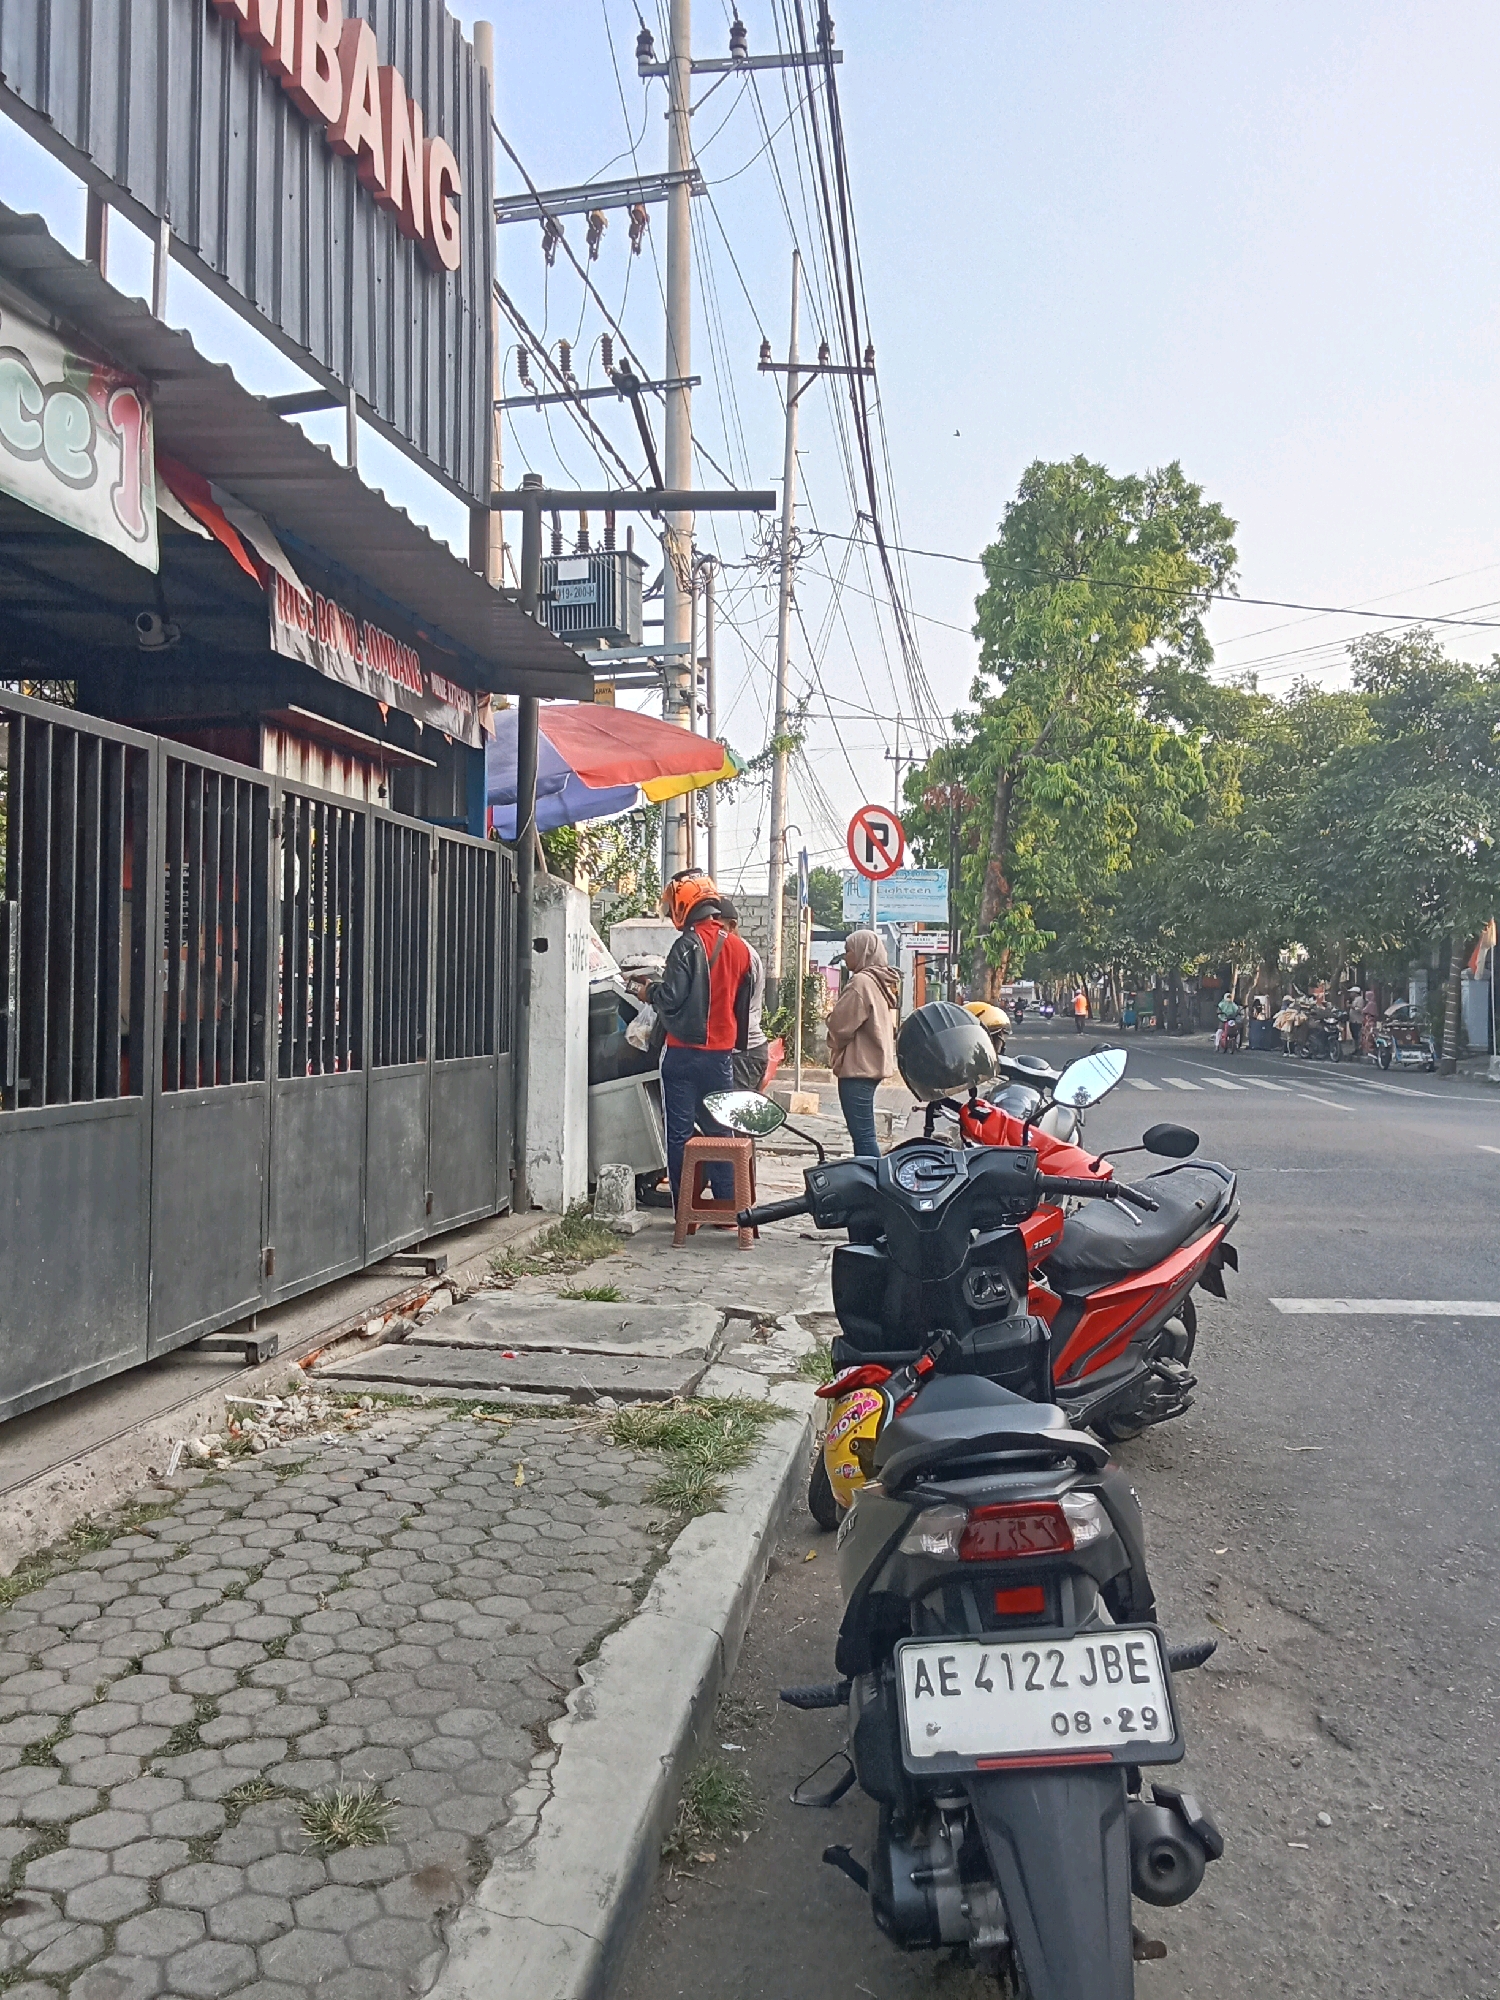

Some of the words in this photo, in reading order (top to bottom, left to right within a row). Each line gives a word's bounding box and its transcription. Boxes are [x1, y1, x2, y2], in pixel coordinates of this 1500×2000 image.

[316, 590, 363, 666] BOWL
[363, 619, 423, 698] JOMBANG
[877, 886, 931, 895] Eighteen
[914, 1655, 962, 1699] AE
[974, 1649, 1069, 1693] 4122
[1079, 1642, 1151, 1687] JBE
